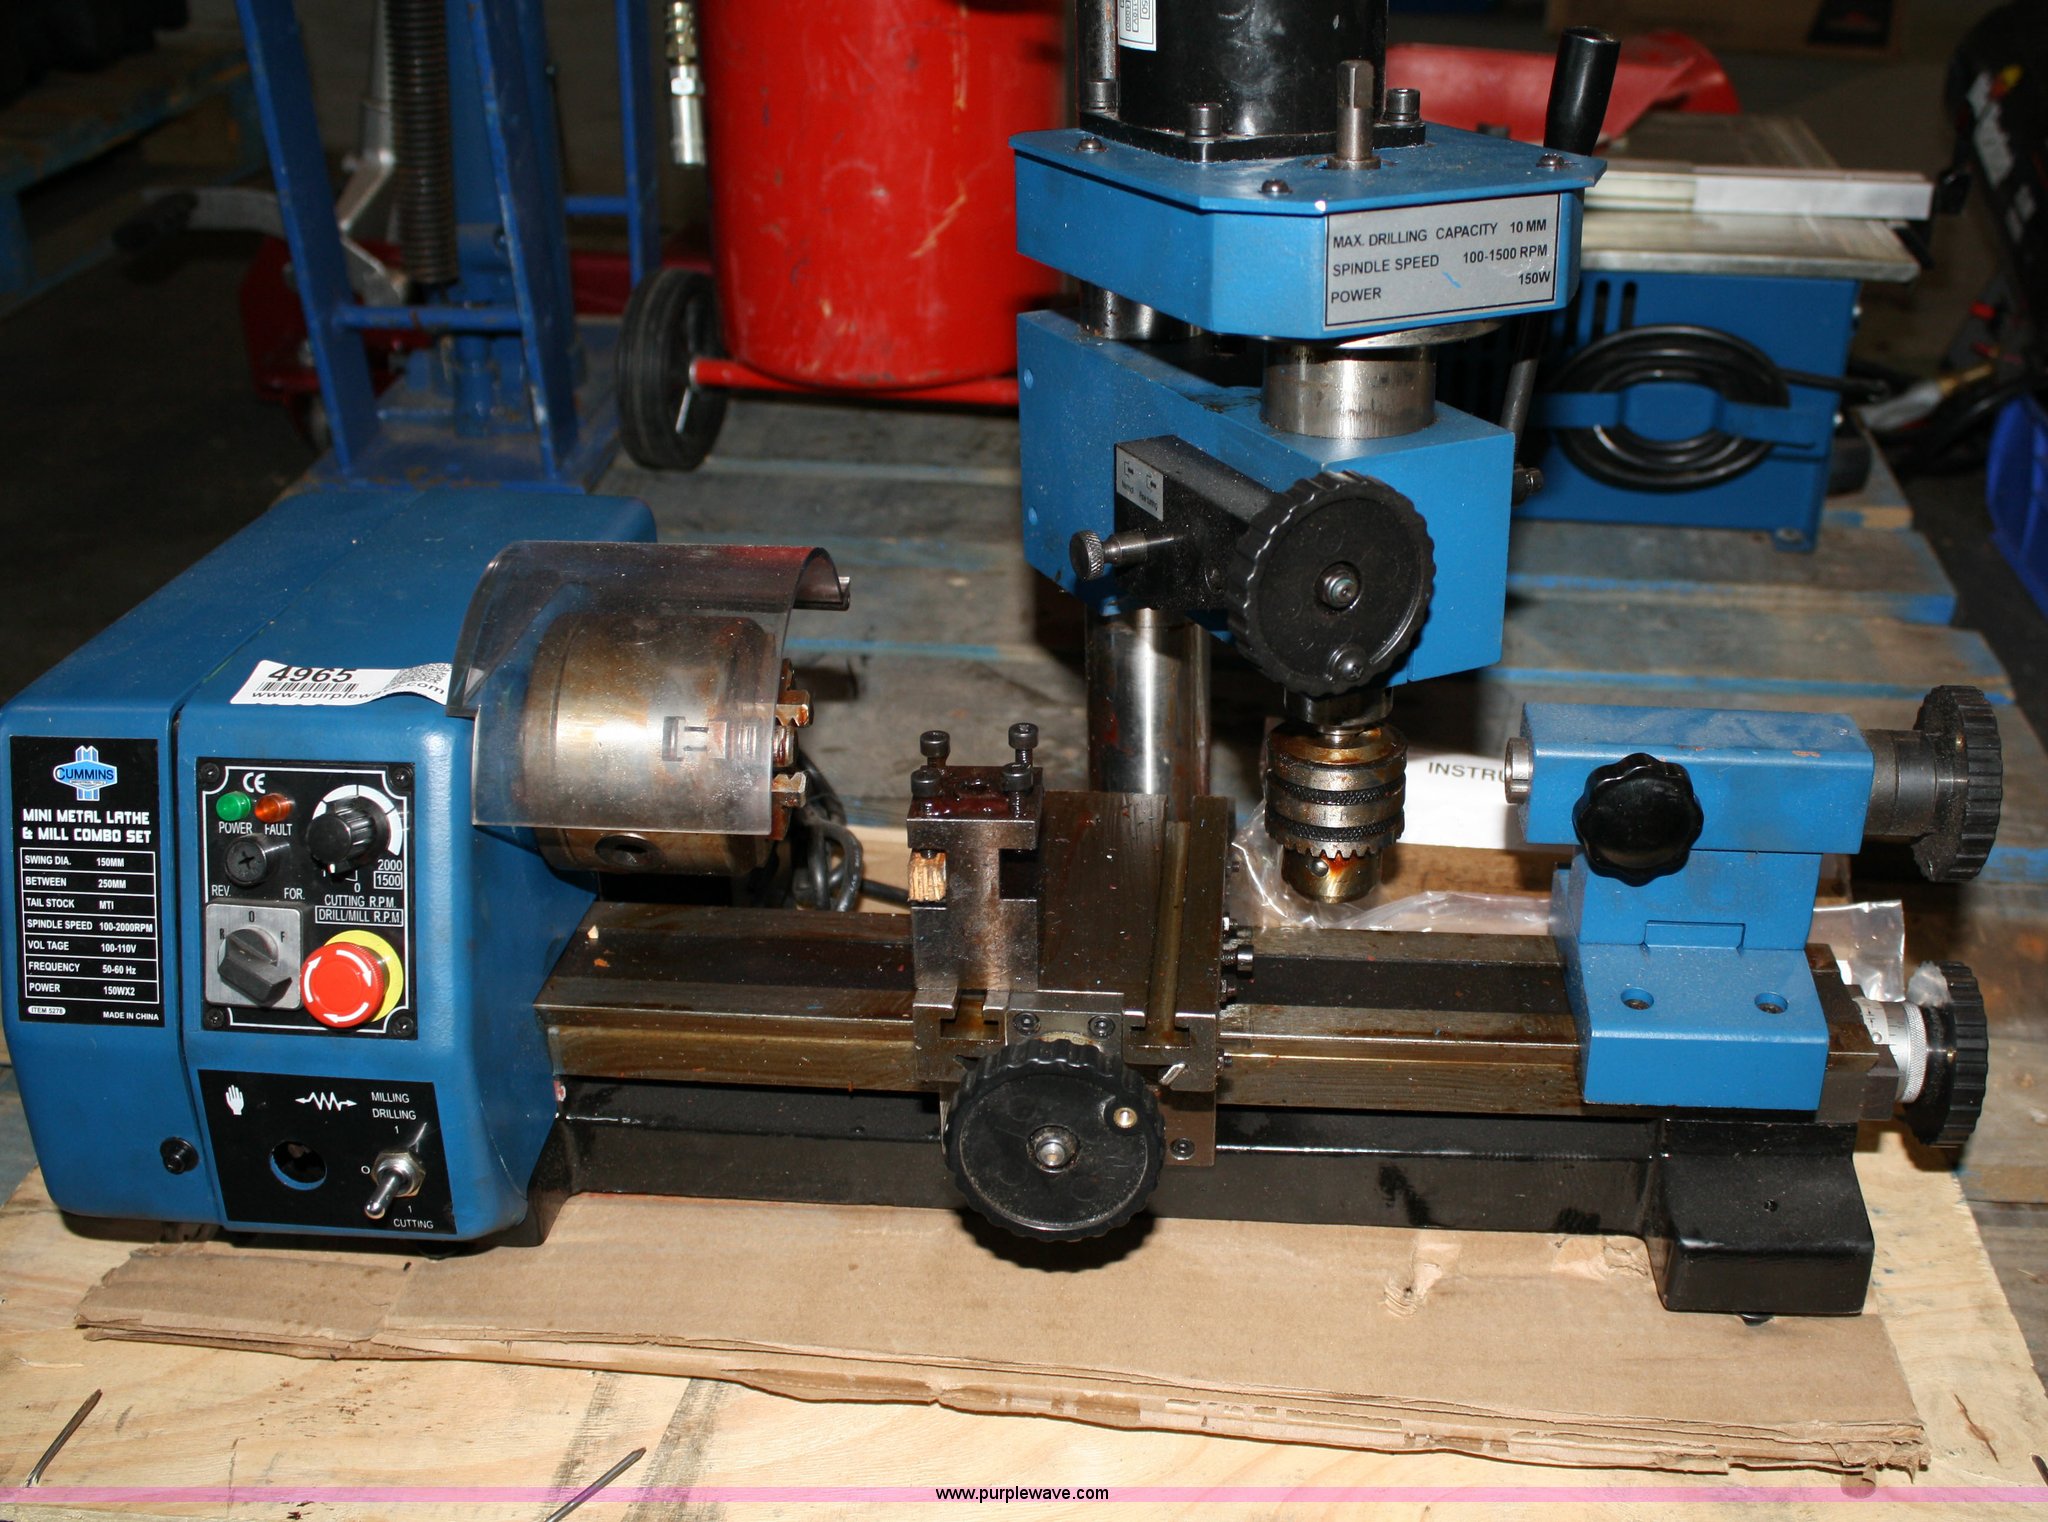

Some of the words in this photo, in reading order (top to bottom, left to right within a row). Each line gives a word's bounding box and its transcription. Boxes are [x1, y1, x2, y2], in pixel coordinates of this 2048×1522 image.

[1333, 234, 1365, 249] MAX.
[1369, 229, 1428, 247] DRILLING
[1436, 222, 1498, 240] CAPACITY
[1510, 220, 1523, 234] 10
[1526, 218, 1547, 233] MM
[1333, 258, 1390, 277] SPINDLE
[1395, 254, 1439, 271] SPEED
[1463, 246, 1517, 264] 100-1500
[1519, 244, 1548, 259] RPM
[1331, 287, 1382, 304] POWER
[1518, 271, 1551, 286] 150W
[268, 666, 356, 683] 4965
[56, 767, 114, 781] CUMMINS
[23, 808, 52, 822] MINI
[56, 809, 101, 823] METAL
[106, 811, 150, 825] LATHE
[218, 820, 253, 835] POWER
[264, 822, 292, 836] FAULT
[22, 827, 33, 840] &
[38, 827, 69, 841] MILL
[74, 828, 121, 842] COMBO
[126, 829, 151, 844] SET
[24, 855, 53, 865] SWING
[54, 855, 71, 866] DIA.
[96, 857, 125, 867] 150MM
[378, 858, 403, 871] 2000
[25, 876, 67, 887] BETWEEN
[98, 878, 126, 889] 250MM
[376, 874, 401, 887] 1500
[211, 884, 231, 897] REV.
[284, 887, 305, 900] FOR.
[354, 882, 361, 893] 0
[26, 897, 44, 907] TAIL
[46, 898, 75, 908] STOCK
[324, 894, 365, 907] CUTTING
[369, 896, 397, 908] R.P.M.
[318, 908, 370, 922] DRILL/MILL
[373, 911, 402, 924] R.P.M.
[27, 918, 62, 929] SPINDLE
[64, 920, 93, 930] SPEED
[99, 921, 153, 933] 100-2000RPM
[219, 928, 225, 940] R
[280, 931, 286, 943] F
[101, 943, 137, 953] 100-110V
[28, 961, 80, 972] FREQUENCY
[102, 964, 124, 974] 50-60
[125, 965, 137, 975] Hz
[29, 982, 61, 993] POWER
[104, 985, 135, 996] 150WX2
[31, 1006, 47, 1014] ITEM
[103, 1011, 124, 1019] MADE
[126, 1011, 134, 1020] IN
[135, 1012, 159, 1021] CHINA
[371, 1091, 410, 1104] MILLING
[372, 1107, 417, 1121] DRILLING
[393, 1218, 434, 1230] CUTTING
